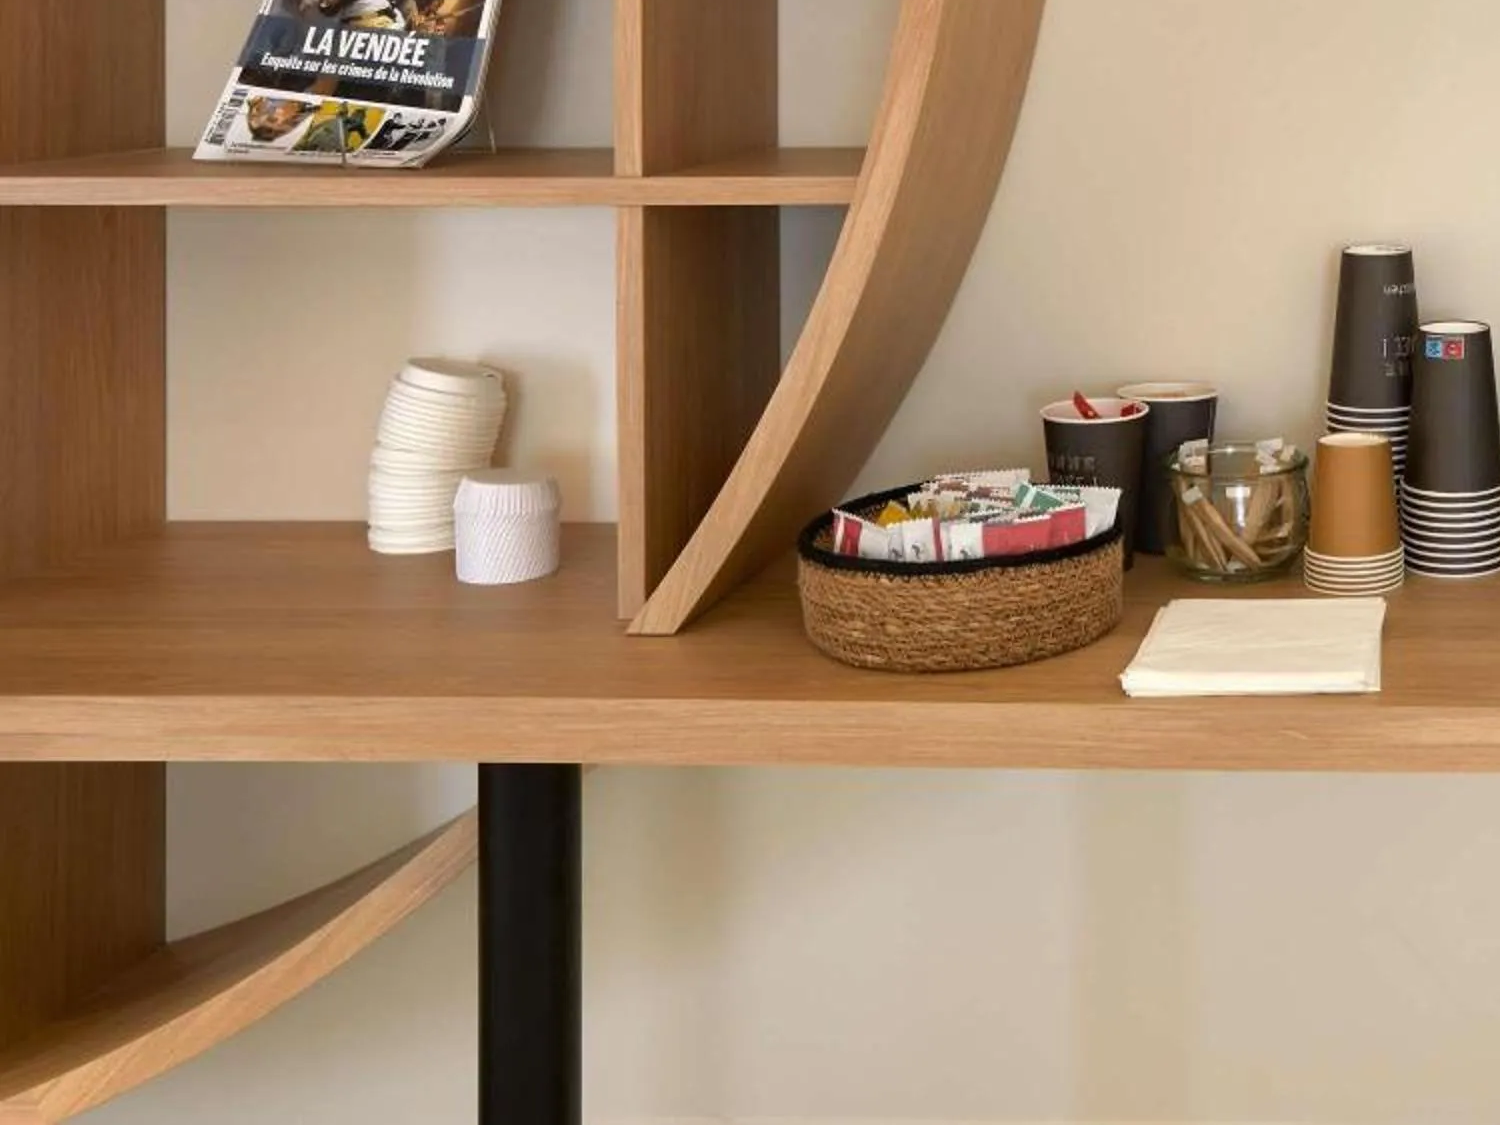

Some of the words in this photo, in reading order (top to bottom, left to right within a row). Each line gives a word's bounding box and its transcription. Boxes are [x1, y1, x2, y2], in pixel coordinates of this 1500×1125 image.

[303, 26, 331, 56] LA
[338, 30, 430, 68] VENDÉE
[260, 52, 303, 71] Enquête
[303, 59, 321, 72] sur
[321, 58, 337, 74] les
[338, 62, 373, 78] crimes
[374, 65, 388, 81] de
[388, 65, 399, 82] la
[400, 68, 455, 90] Révolution
